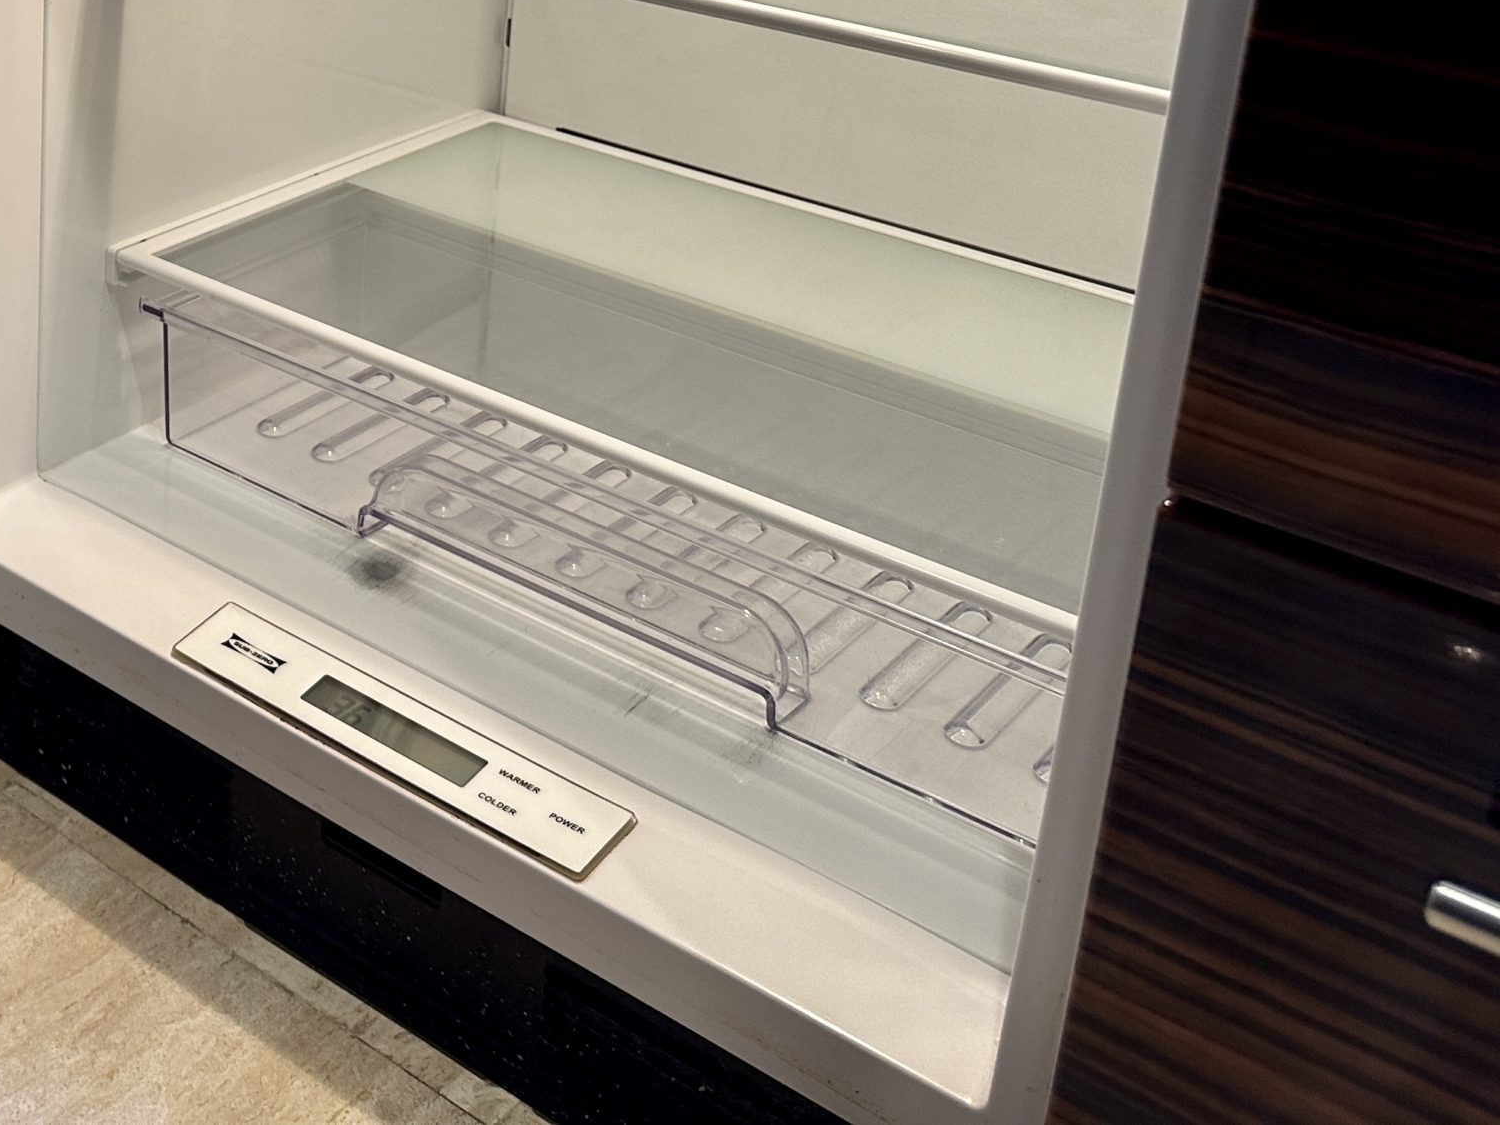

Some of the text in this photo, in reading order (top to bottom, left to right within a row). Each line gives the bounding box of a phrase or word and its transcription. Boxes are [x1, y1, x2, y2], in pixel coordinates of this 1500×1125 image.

[499, 768, 541, 794] WARMER
[478, 792, 517, 816] COLDER
[549, 812, 585, 834] POWER
